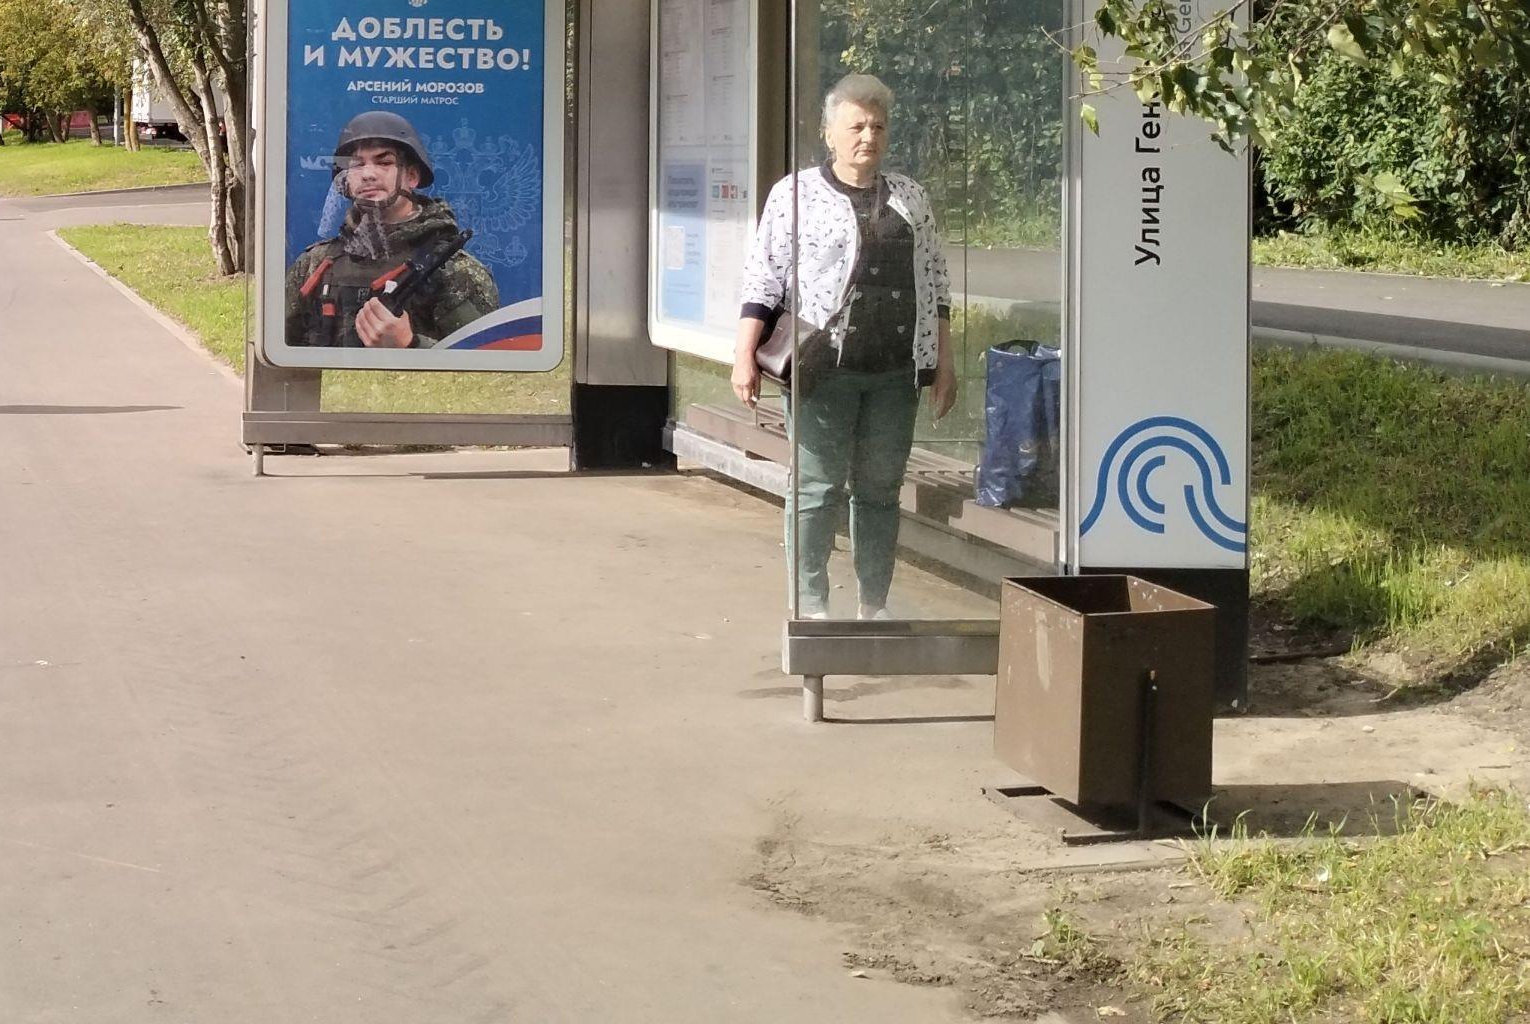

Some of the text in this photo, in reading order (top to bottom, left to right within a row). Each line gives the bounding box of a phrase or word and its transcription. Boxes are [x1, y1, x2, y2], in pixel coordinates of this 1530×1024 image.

[331, 16, 504, 41] ДОБЛЕСТЬ
[304, 45, 530, 71] И МУЖЕСТВО!
[347, 79, 485, 94] АРСЕНИЙ МОРОЗОВ
[371, 95, 459, 105] СТАРШИЙ МАТРОС
[1134, 167, 1164, 267] Улица
